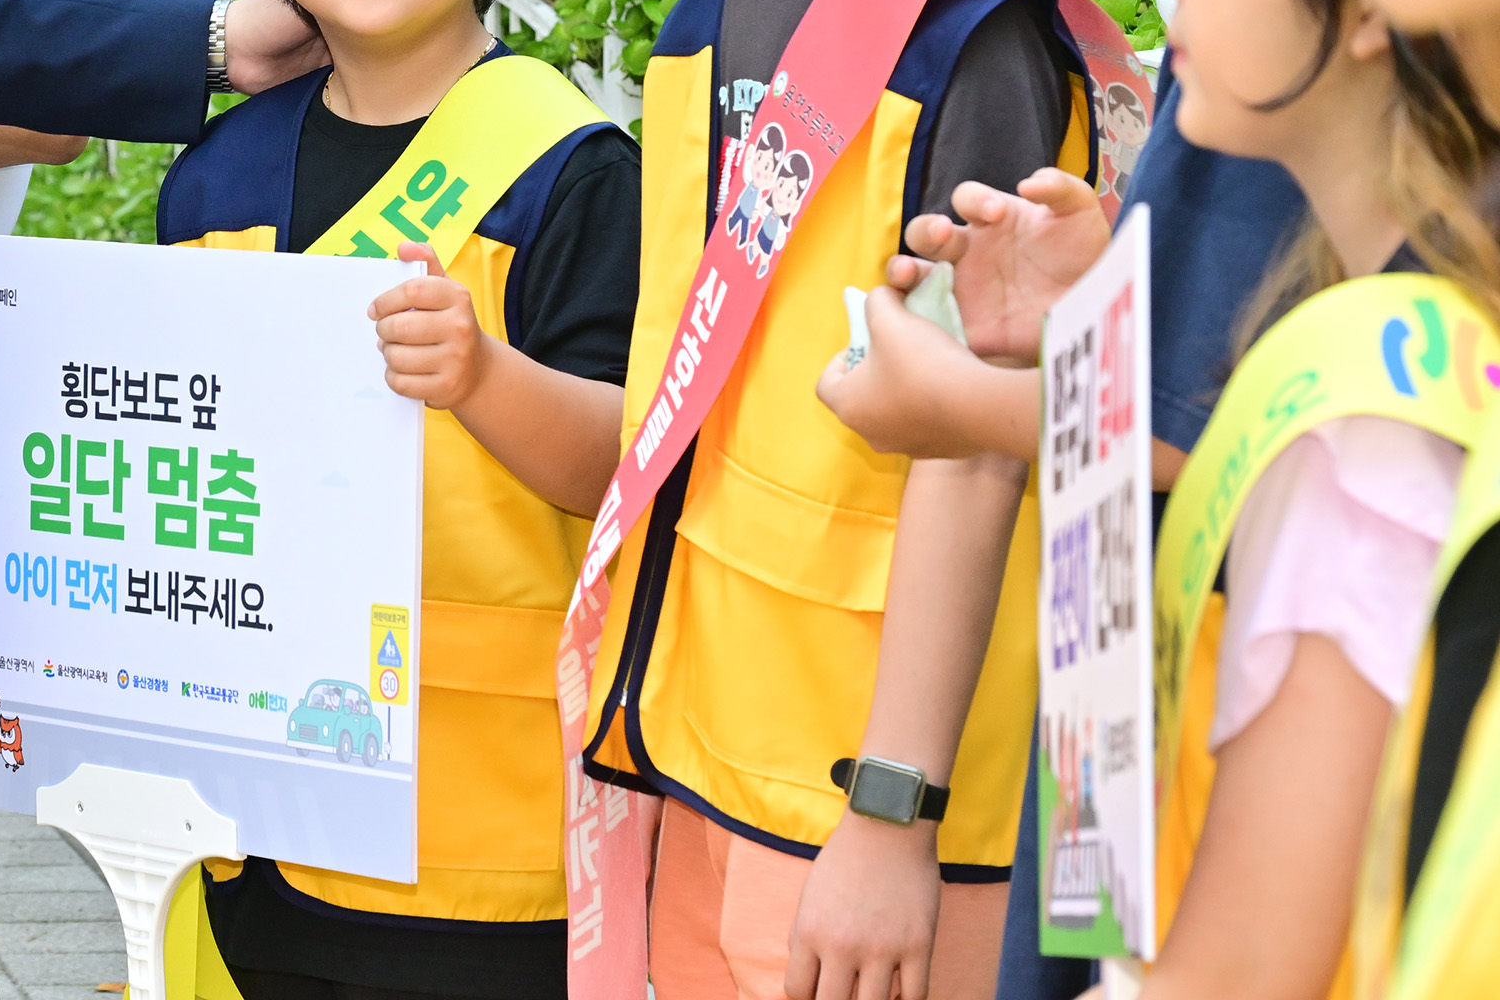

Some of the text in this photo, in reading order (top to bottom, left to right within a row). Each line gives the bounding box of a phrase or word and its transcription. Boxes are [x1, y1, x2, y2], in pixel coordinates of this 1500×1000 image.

[783, 84, 845, 155] 용연초등학교
[61, 362, 221, 431] 횡단보도 앞
[23, 432, 261, 556] 일단 멈춤
[4, 551, 275, 633] 아이 먼저 보내주세요.
[0, 656, 288, 713] 울산광역시 울산광역시교육청 울산경찰청 한국도로교통공단 아이먼저
[383, 676, 396, 692] 30
